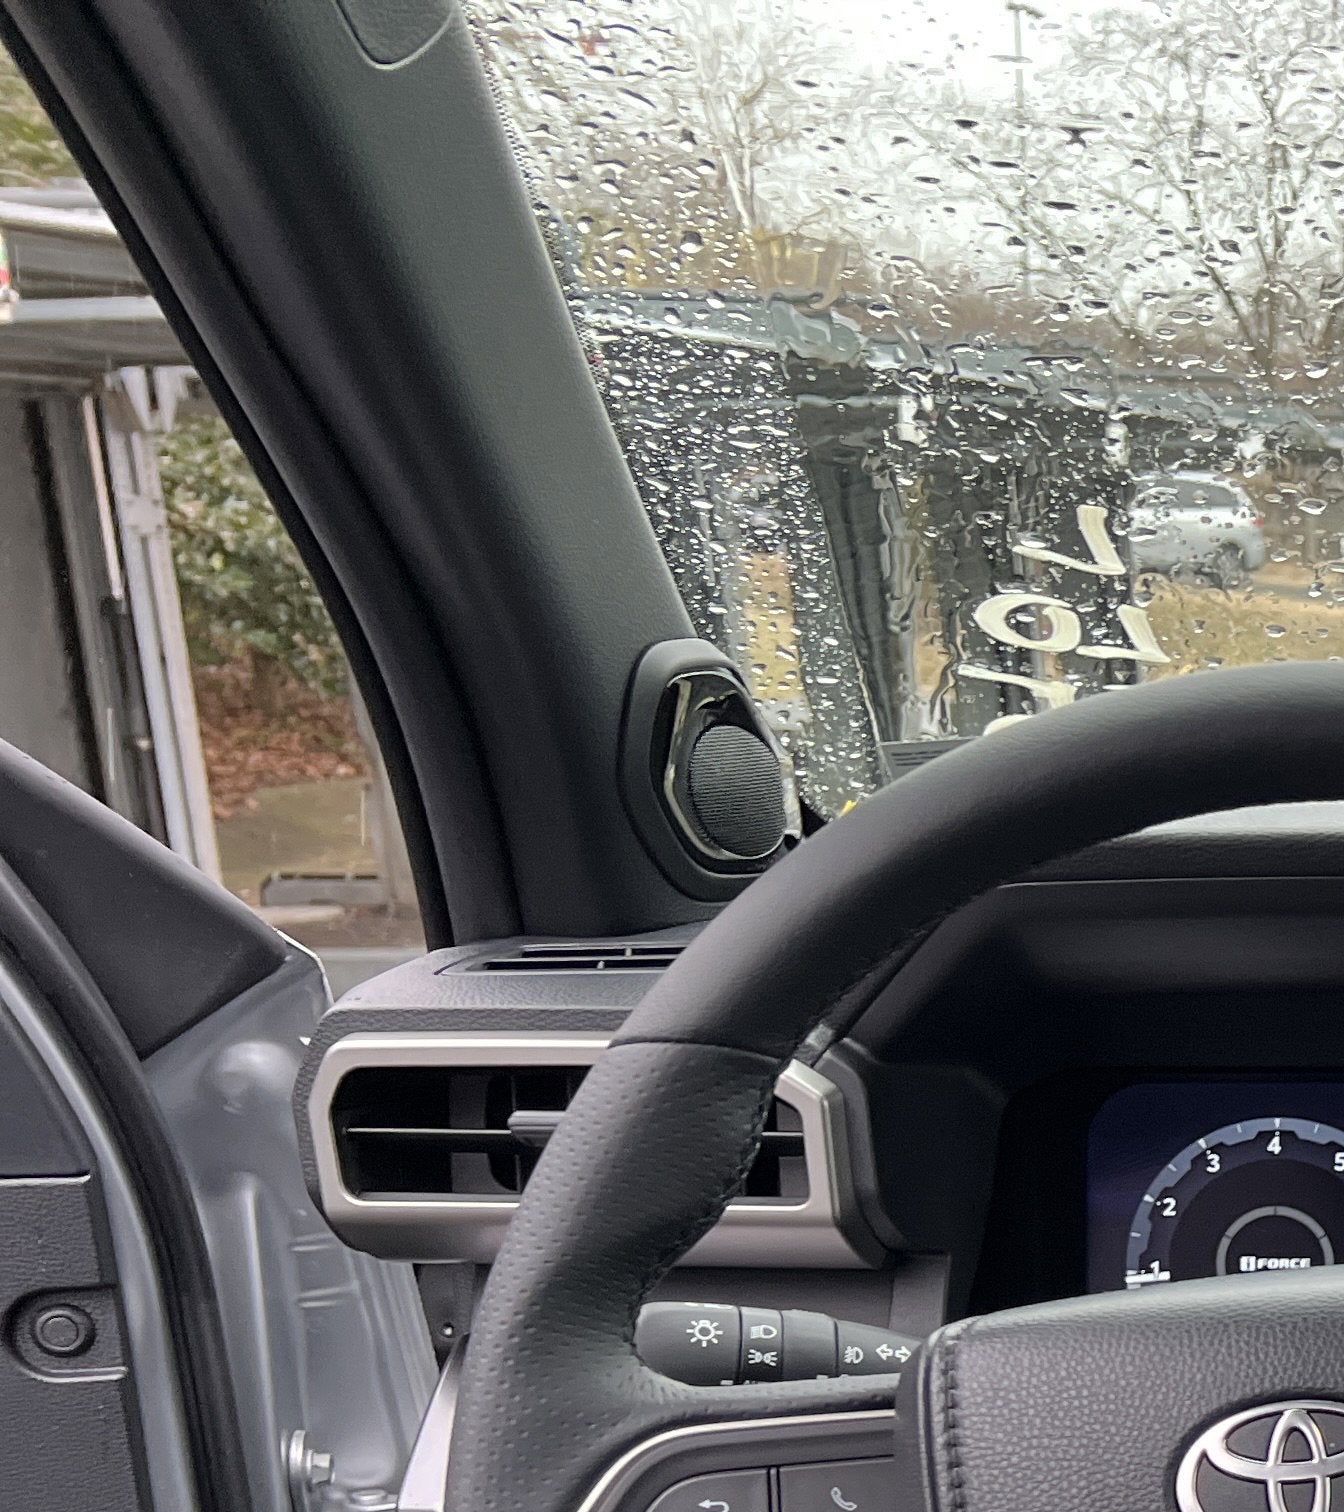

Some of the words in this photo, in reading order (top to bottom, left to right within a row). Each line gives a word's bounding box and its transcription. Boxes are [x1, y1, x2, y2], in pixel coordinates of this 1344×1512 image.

[1266, 1136, 1282, 1155] 4
[1206, 1153, 1221, 1173] 3
[1162, 1198, 1177, 1217] 2
